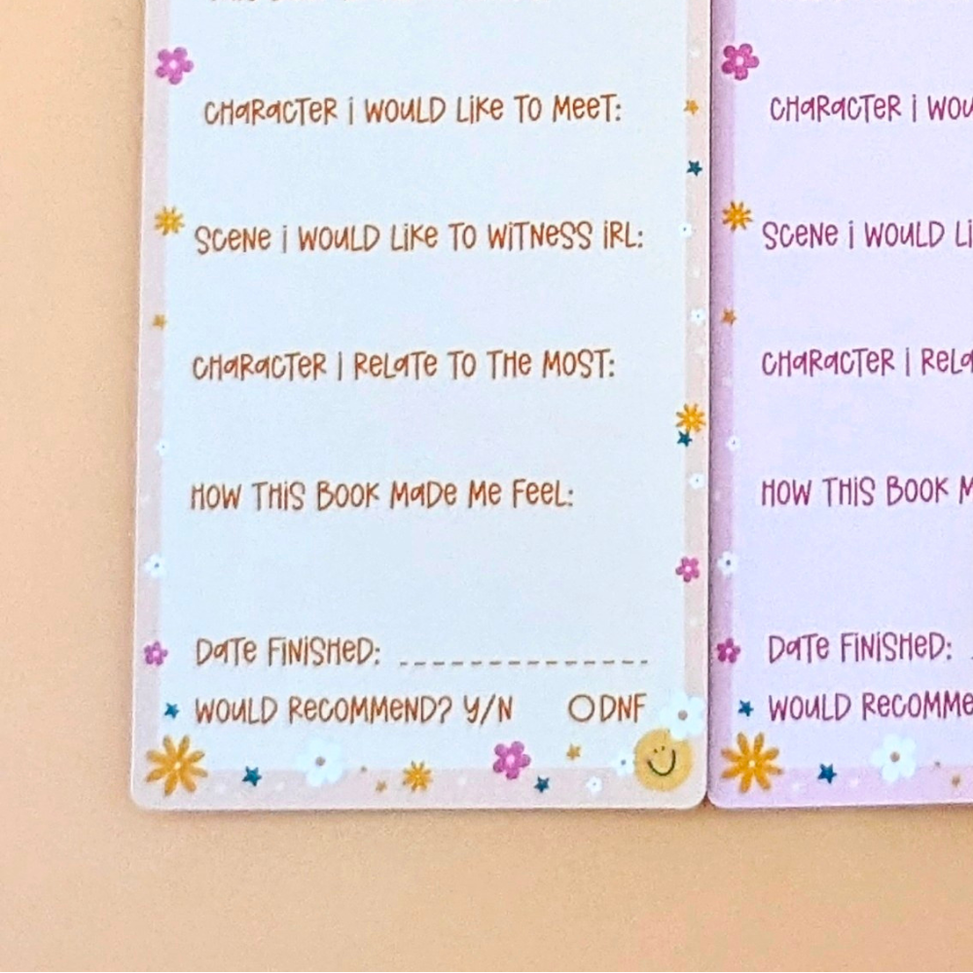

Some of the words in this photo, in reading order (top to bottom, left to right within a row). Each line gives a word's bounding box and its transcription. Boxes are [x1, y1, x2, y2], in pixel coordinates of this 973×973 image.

[203, 96, 339, 127] CHaRaCTeR
[363, 95, 447, 125] WOuLD
[455, 94, 505, 125] LiKe
[512, 93, 543, 125] TO
[551, 93, 622, 124] MeeT:
[769, 93, 903, 124] CHaRaCTeR
[193, 225, 272, 256] SCeNe
[297, 223, 381, 253] WOuLD
[390, 222, 439, 253] LiKe
[447, 221, 478, 252] TO
[486, 220, 594, 252] WiTNeSS
[603, 219, 644, 251] iRL:
[761, 220, 839, 251] SCeNe
[863, 219, 946, 249] WOuLD
[191, 351, 328, 383] CHaRaCTeR
[353, 350, 438, 381] ReLaTe
[446, 349, 477, 381] TO
[485, 348, 533, 381] THe
[541, 347, 615, 380] MOST:
[761, 347, 896, 378] CHaRaCTeR
[189, 482, 243, 511] HOW
[250, 480, 307, 512] THiS
[316, 480, 381, 512] BOOK
[388, 479, 458, 511] MaDe
[467, 479, 503, 510] Me
[512, 477, 574, 510] FeeL:
[761, 478, 813, 508] HOW
[821, 475, 876, 508] THiS
[886, 474, 950, 507] BOOK
[195, 636, 258, 668] DaTe
[267, 635, 381, 668] FiNiSHeD:
[768, 632, 830, 665] DaTe
[840, 630, 953, 664] FiNiSHeD:
[194, 695, 279, 726] WOuLD
[287, 694, 453, 726] ReCOMMeND?
[462, 692, 514, 728] y/N
[768, 692, 852, 723] WOuLD
